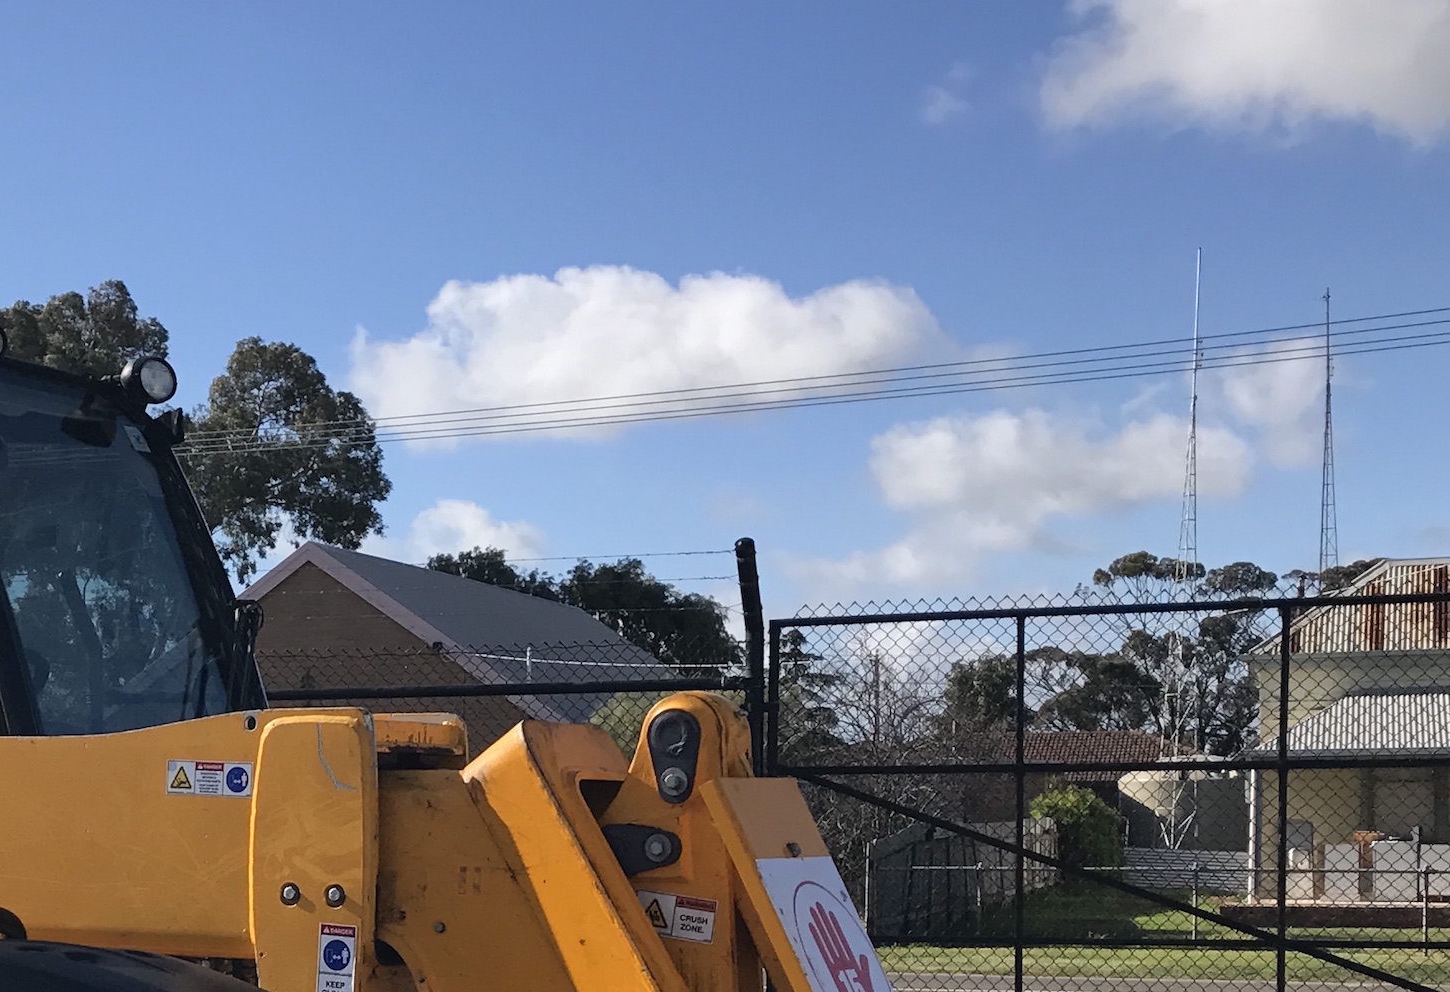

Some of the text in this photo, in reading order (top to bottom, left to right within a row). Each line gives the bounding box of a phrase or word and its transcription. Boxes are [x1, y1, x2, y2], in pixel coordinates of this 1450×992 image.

[679, 914, 708, 925] CRUSH
[330, 927, 354, 936] DANGER
[325, 980, 346, 989] KEEP
